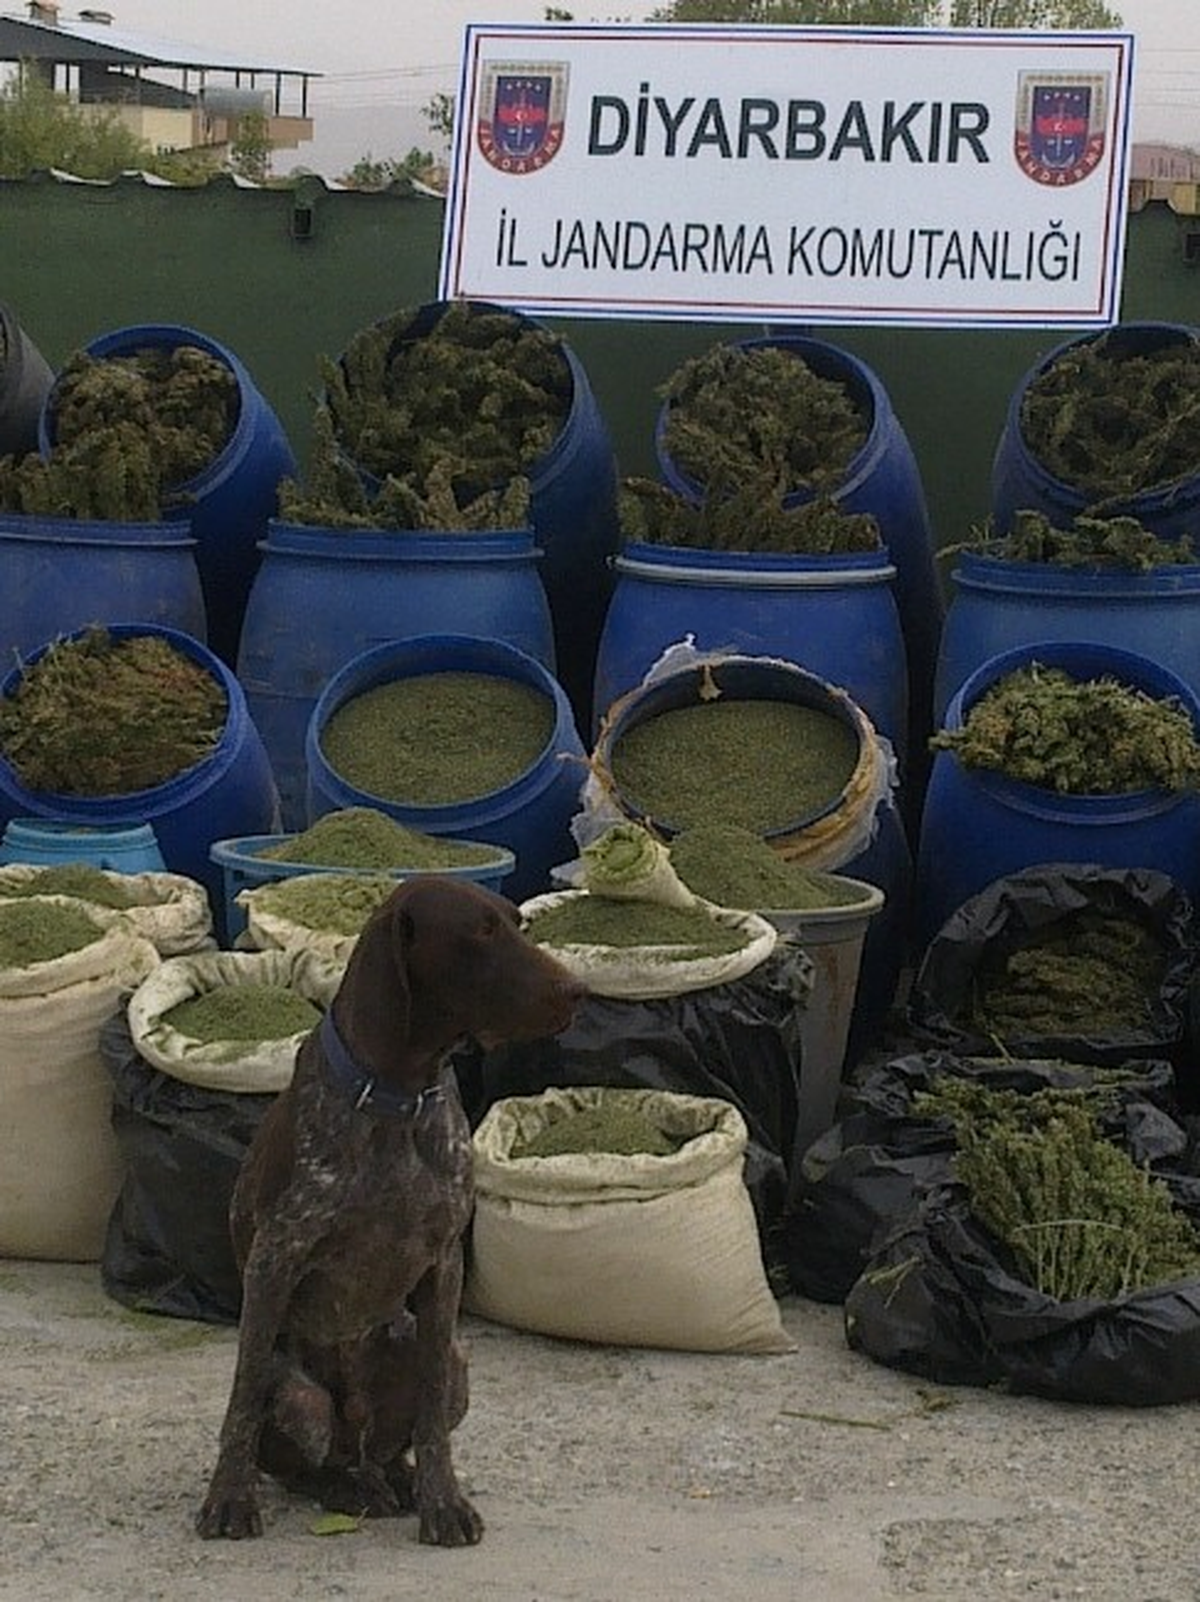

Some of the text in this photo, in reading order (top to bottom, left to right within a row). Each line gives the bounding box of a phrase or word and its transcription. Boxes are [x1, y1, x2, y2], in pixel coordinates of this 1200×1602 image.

[479, 128, 560, 172] JANDARMA
[588, 81, 990, 164] DİYARBAKIR
[1018, 138, 1102, 183] JANDARMA
[496, 208, 1081, 282] İL JANDARMA KOMUTANLIĞI
